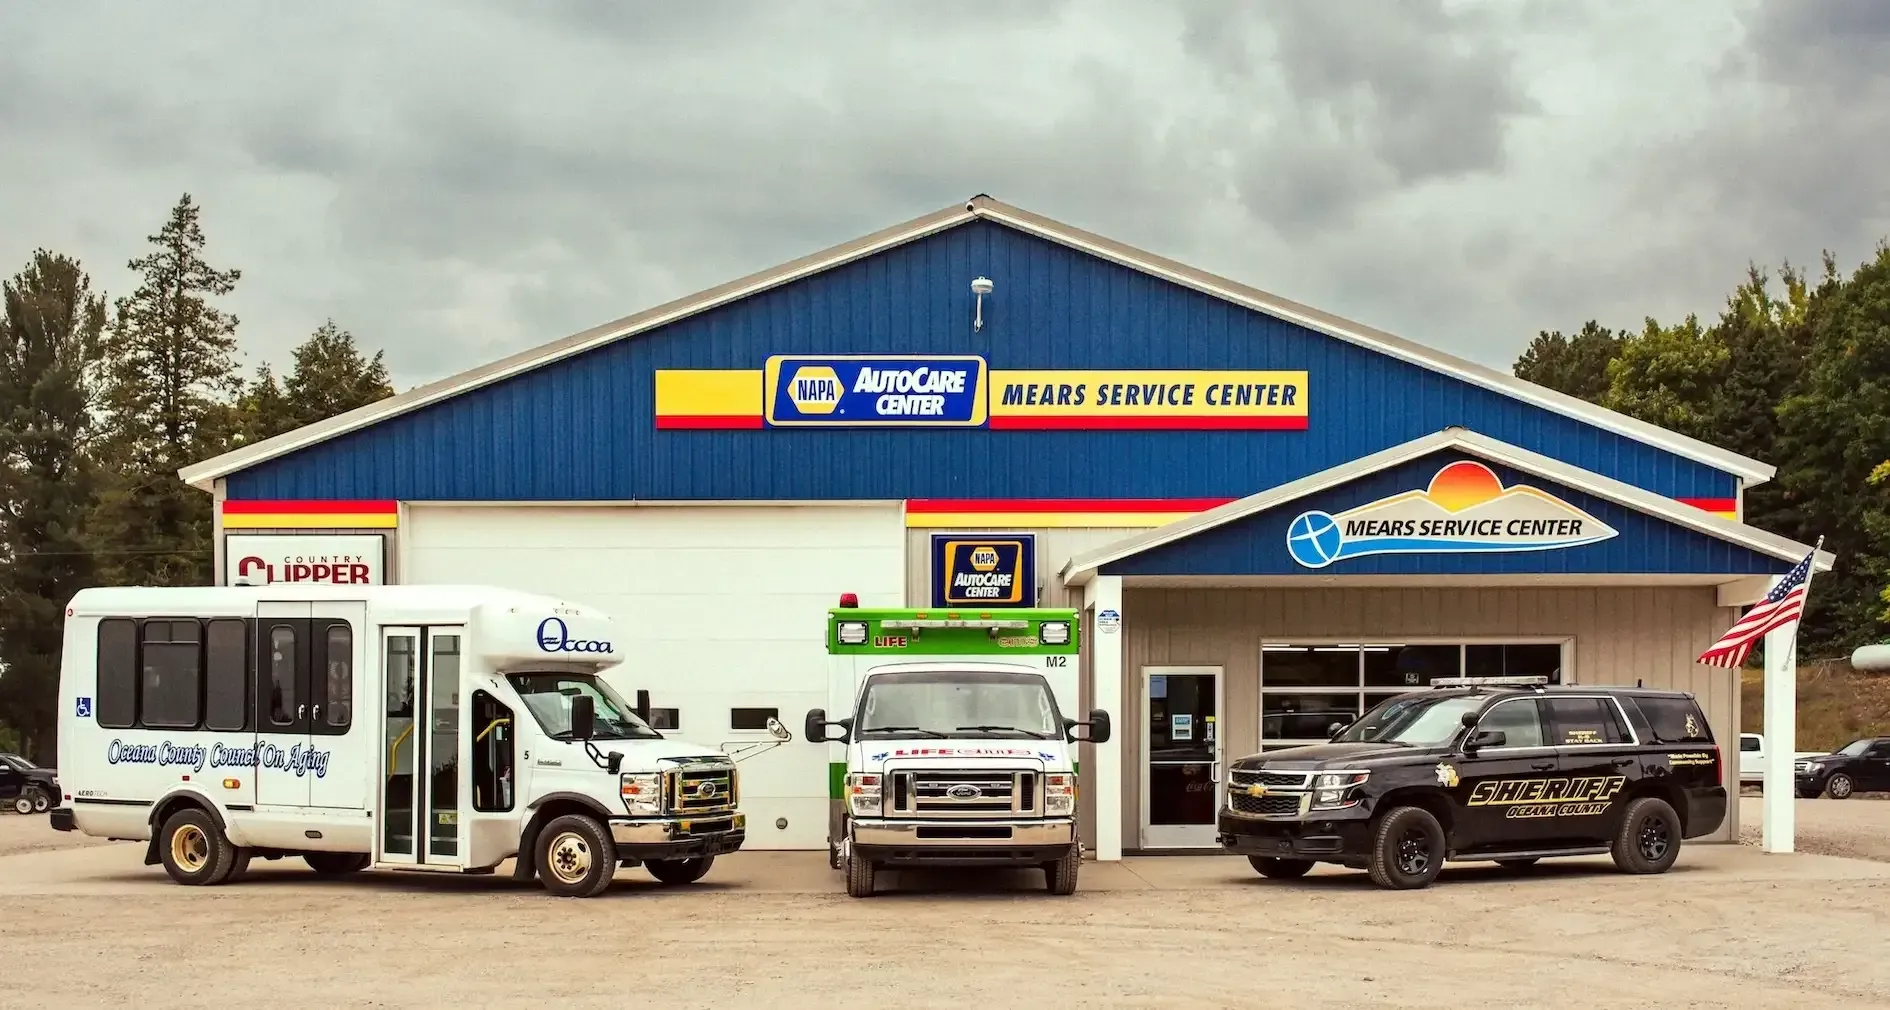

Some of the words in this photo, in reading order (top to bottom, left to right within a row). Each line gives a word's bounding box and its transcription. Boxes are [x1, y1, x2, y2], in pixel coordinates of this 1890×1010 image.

[797, 379, 835, 401] NAPA
[1002, 384, 1086, 407] MEARS
[1096, 384, 1195, 407] SERVICE
[1205, 384, 1297, 407] CENTER
[876, 395, 945, 416] CENTER
[1346, 520, 1415, 536] MEARS
[1418, 520, 1504, 536] SERVICE
[1507, 519, 1583, 536] CENTER
[284, 555, 363, 564] COUNTRY
[975, 553, 995, 565] NAPA
[965, 586, 1000, 598] CENTER
[874, 635, 908, 648] LIFE
[1046, 656, 1067, 668] M2
[108, 738, 157, 765] Oceana
[158, 740, 207, 772] County
[210, 741, 265, 768] Council
[263, 743, 285, 768] On
[284, 742, 330, 778] Aging
[523, 750, 530, 760] 5
[1467, 775, 1627, 806] SHERIFF
[1506, 804, 1557, 819] OCEANA
[1558, 801, 1613, 817] COUNTY
